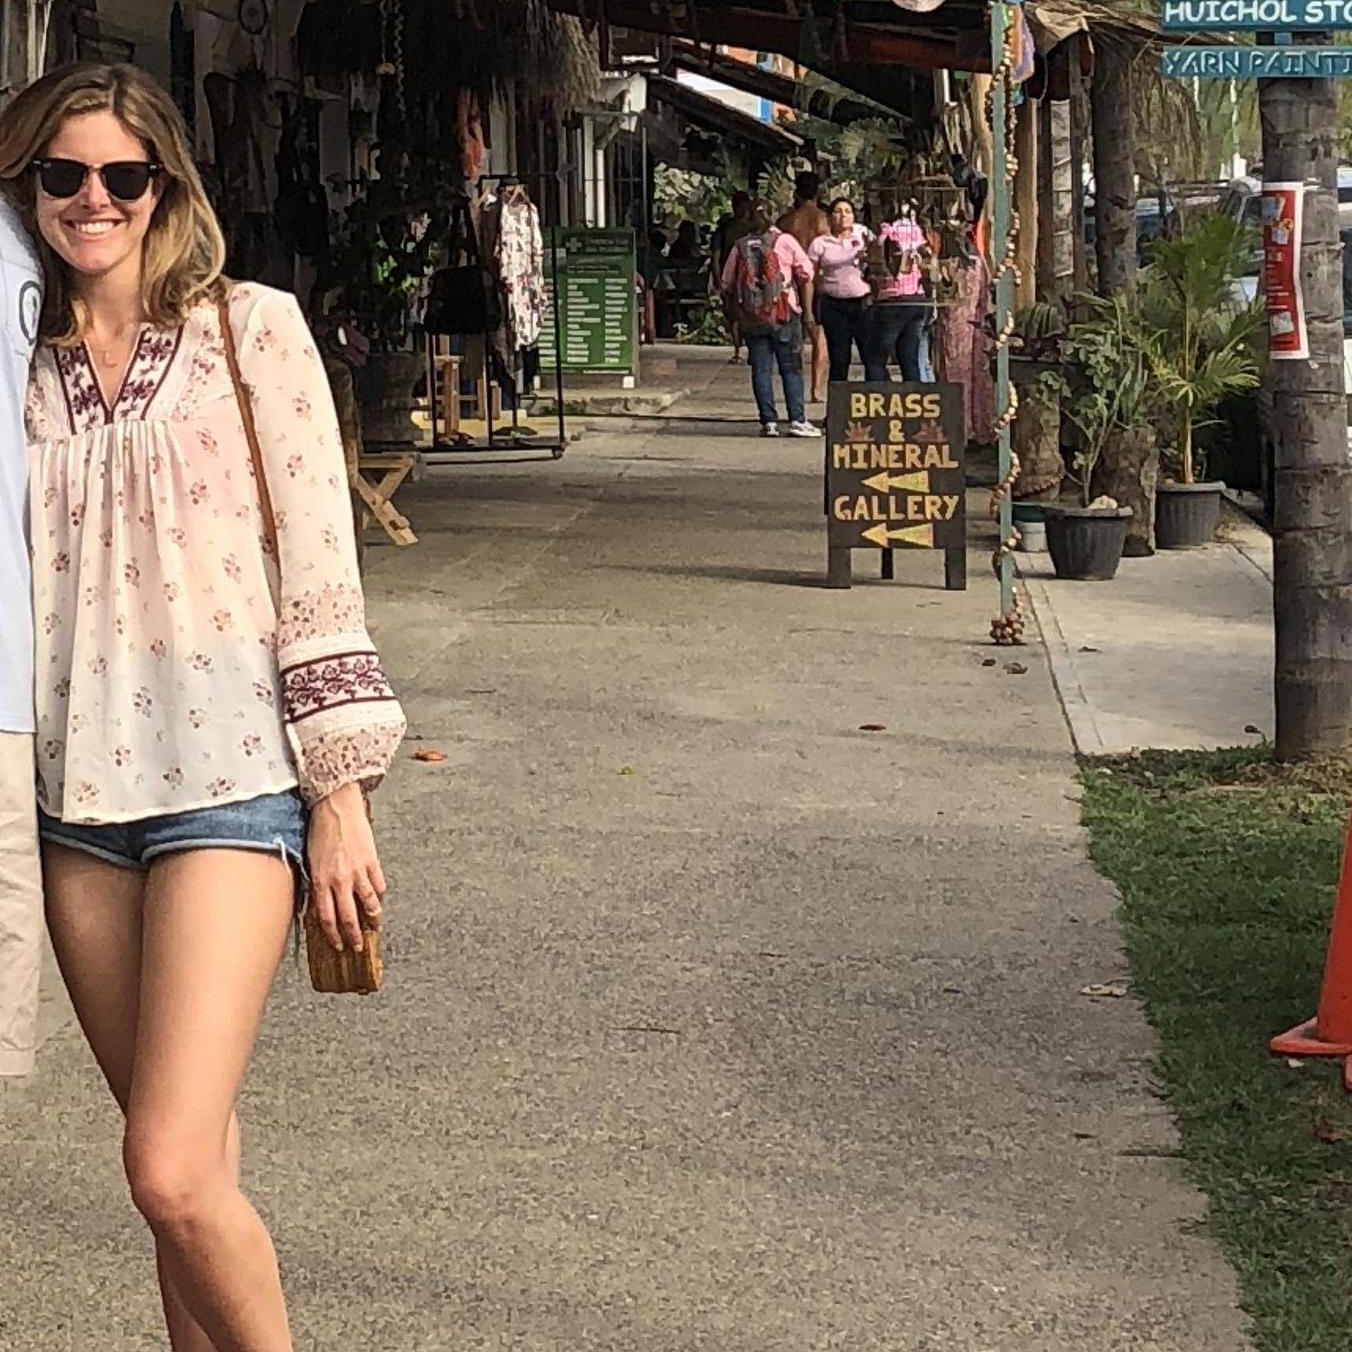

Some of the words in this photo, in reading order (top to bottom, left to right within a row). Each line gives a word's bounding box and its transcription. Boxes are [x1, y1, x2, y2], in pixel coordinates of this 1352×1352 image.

[1165, 0, 1297, 23] HUICHOL
[1161, 50, 1240, 74] YARN
[850, 392, 942, 419] BRASS
[888, 419, 905, 443] &
[832, 443, 960, 469] MINERAL
[833, 495, 960, 521] GALLERY
